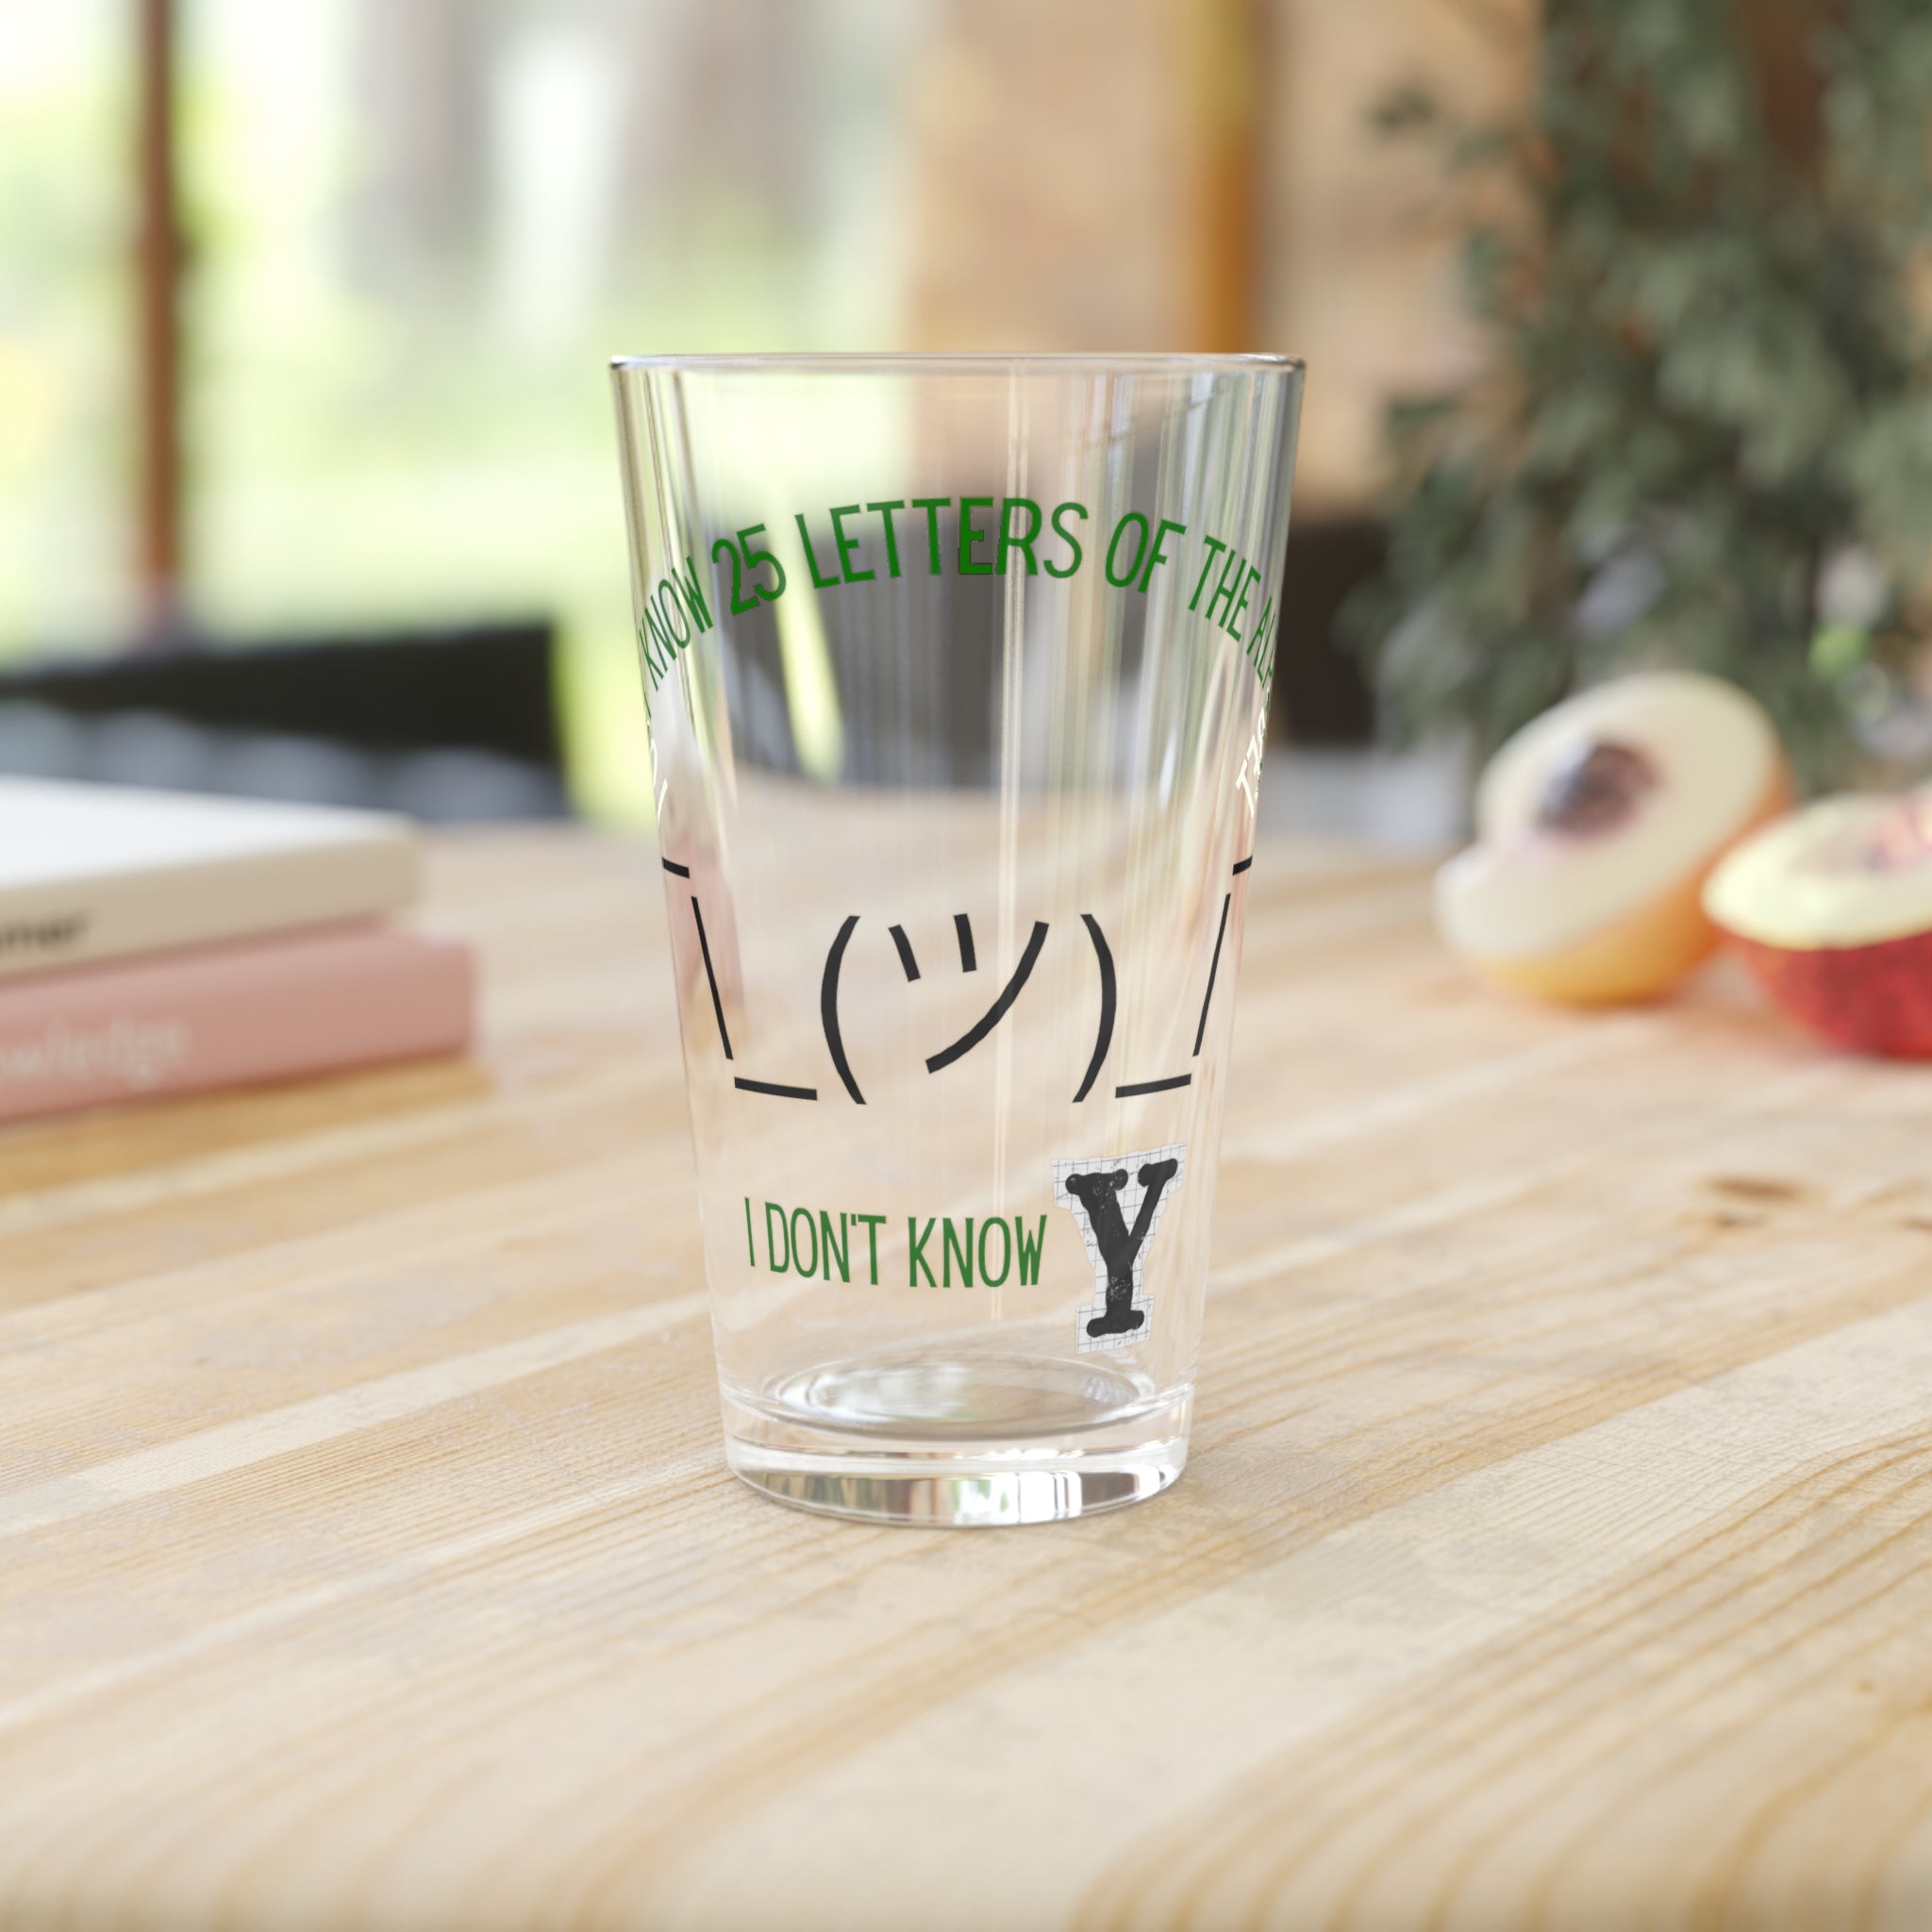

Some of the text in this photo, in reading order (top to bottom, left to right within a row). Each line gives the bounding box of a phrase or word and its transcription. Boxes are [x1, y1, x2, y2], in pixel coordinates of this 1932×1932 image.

[639, 556, 714, 692] KNOW
[711, 524, 787, 616] 25
[794, 497, 1090, 589] LETTERS
[1105, 511, 1188, 593] OF
[1188, 535, 1262, 643] THE
[744, 1157, 1179, 1339] I DON'T KNOW Y
